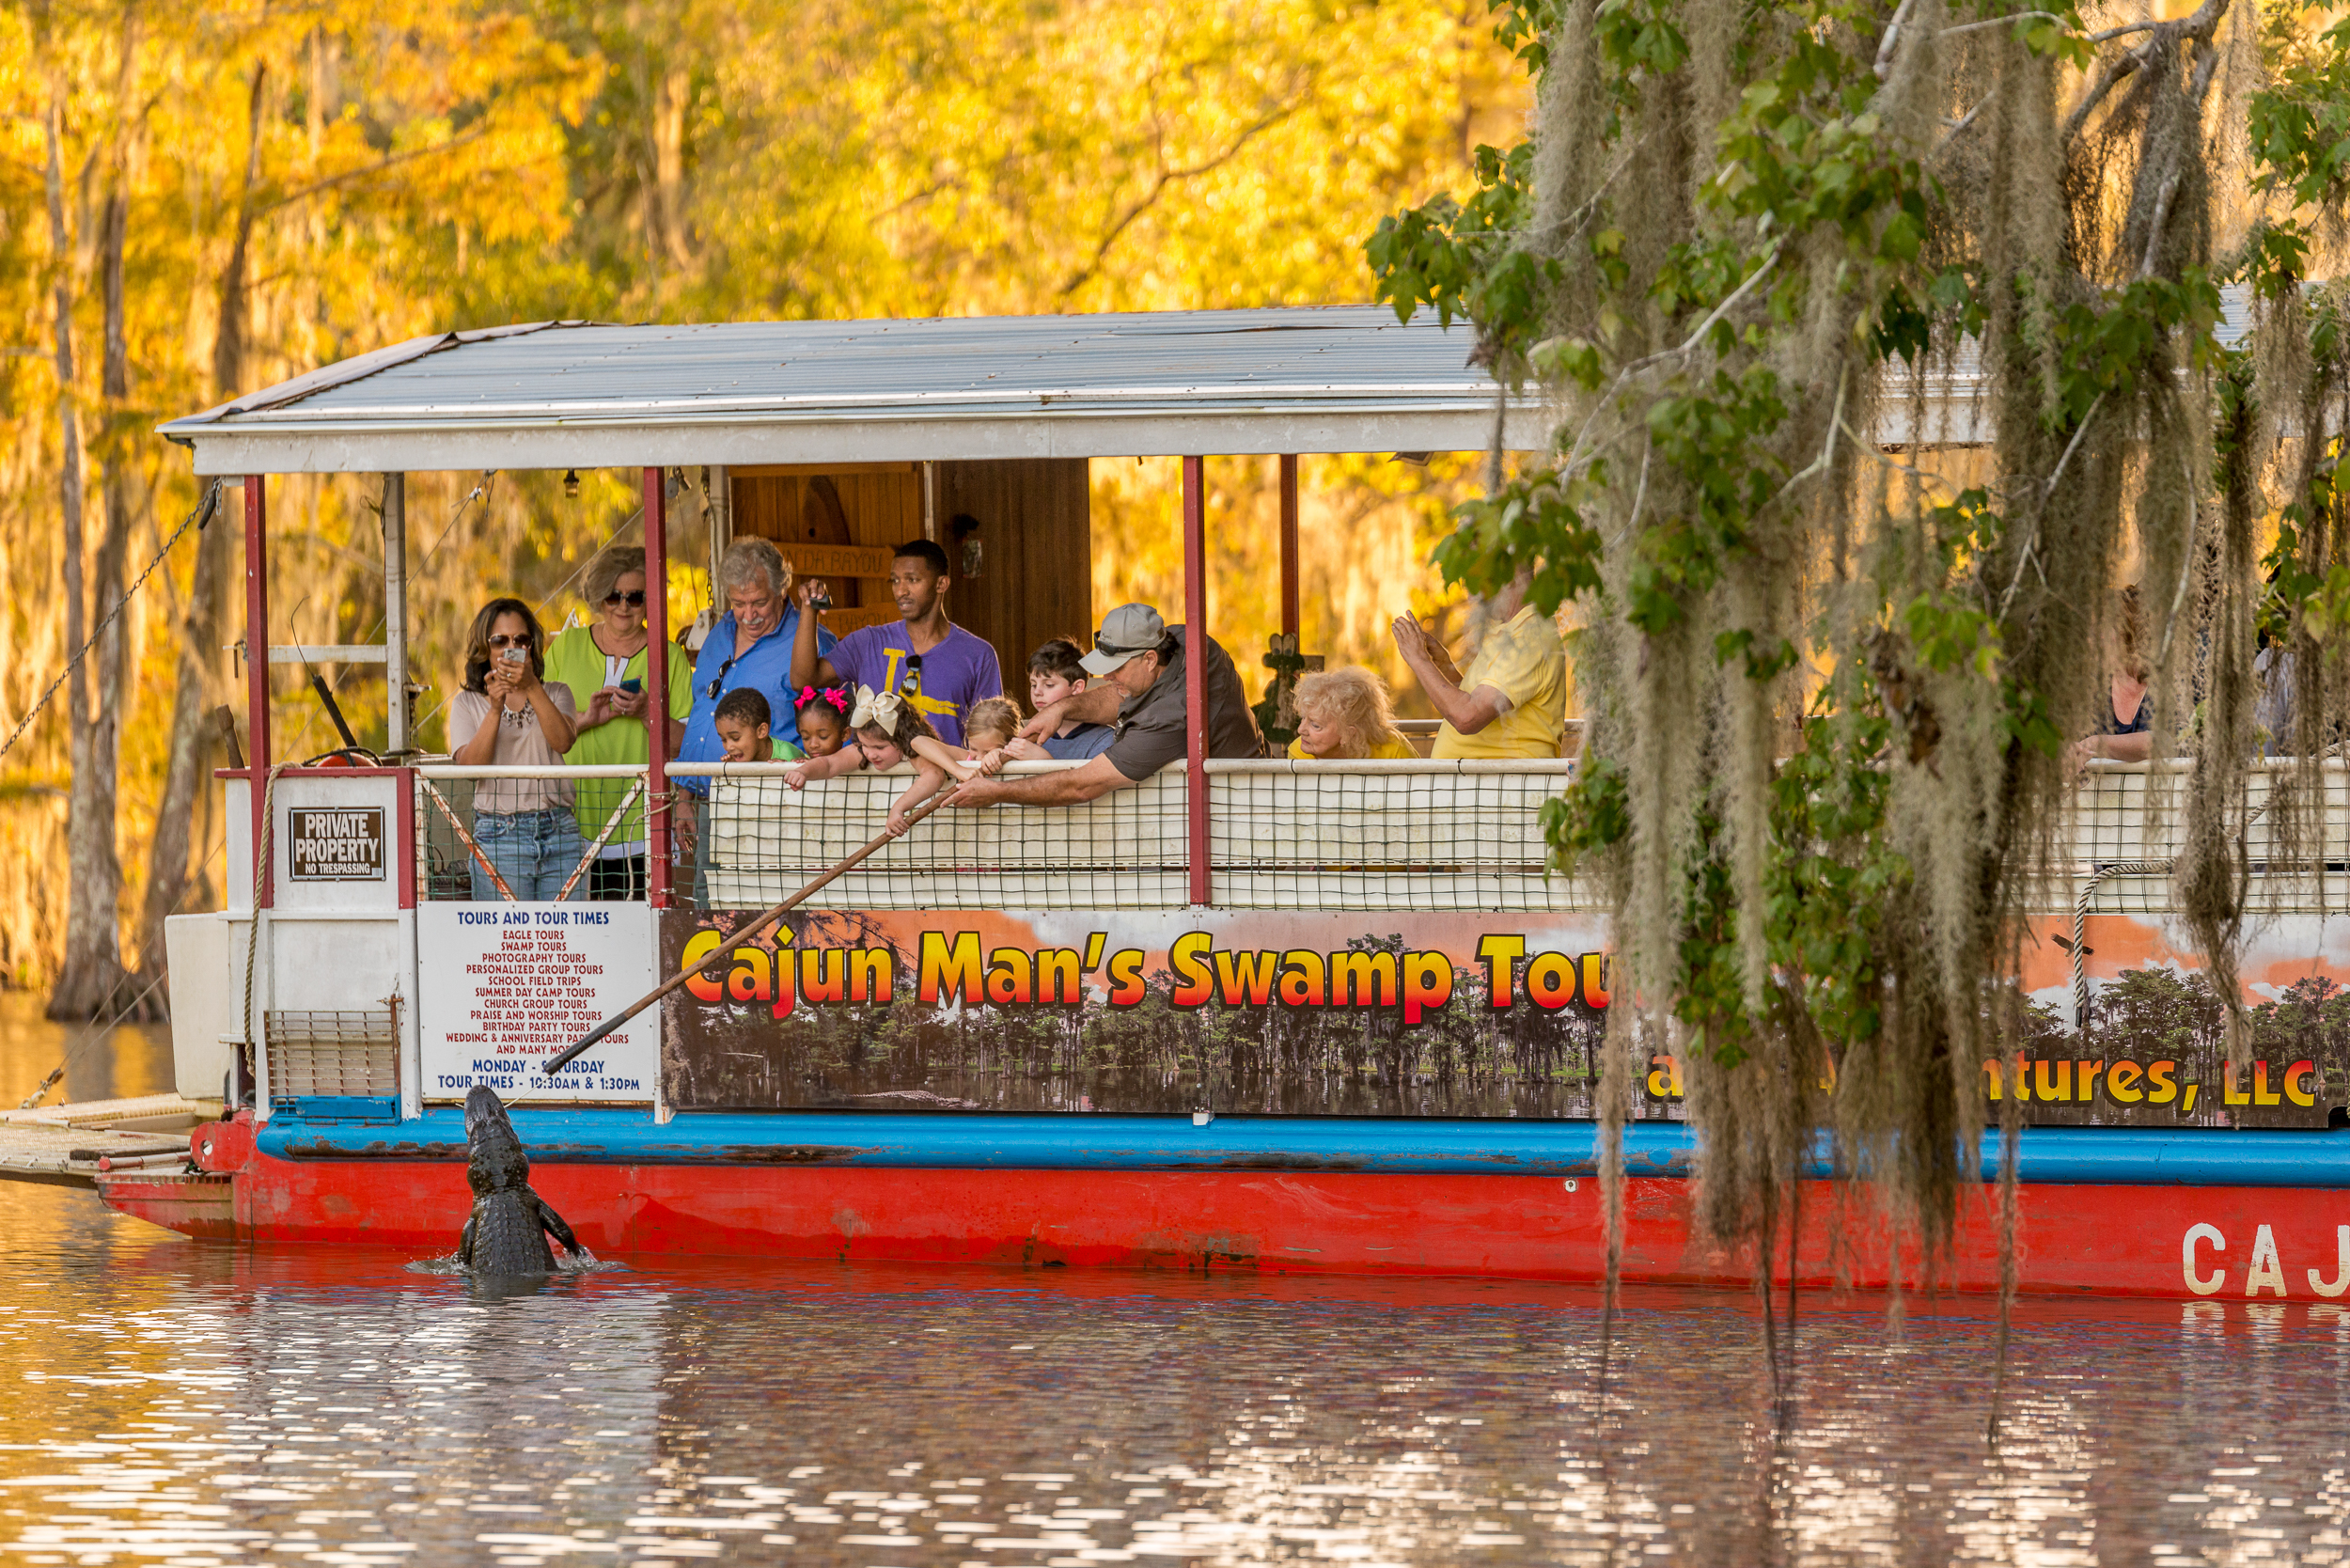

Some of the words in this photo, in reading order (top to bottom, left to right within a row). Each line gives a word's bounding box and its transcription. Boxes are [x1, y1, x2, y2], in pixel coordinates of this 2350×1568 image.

[831, 553, 883, 573] BAYOU
[305, 813, 368, 839] PRIVATE
[295, 838, 379, 863] PROPERTY
[305, 863, 317, 874] NO
[319, 863, 370, 875] TRESPASSING
[458, 912, 497, 925] TOURS
[503, 912, 529, 924] AND
[535, 912, 568, 925] TOUR
[572, 912, 609, 924] TIMES
[503, 930, 532, 940] EAGLE
[535, 930, 564, 940] TOURS
[501, 941, 534, 951] SWAMP
[537, 941, 567, 952] TOURS
[482, 952, 554, 963] PHOTOGRAPHY
[556, 953, 587, 964] TOURS
[466, 964, 535, 975] PERSONALIZED
[538, 964, 571, 975] GROUP
[573, 964, 603, 975] TOURS
[488, 976, 526, 986] SCHOOL
[528, 976, 554, 986] FIELD
[556, 976, 582, 986] TRIPS
[679, 925, 893, 1021] Cajun
[916, 930, 1148, 1010] Man's
[1167, 931, 1454, 1030] Swamp
[475, 987, 512, 997] SUMMER
[515, 987, 532, 997] DAY
[536, 987, 563, 997] CAMP
[566, 987, 596, 998] TOURS
[484, 998, 519, 1009] CHURCH
[522, 998, 555, 1010] GROUP
[557, 998, 588, 1010] TOURS
[470, 1010, 503, 1020] PRAISE
[505, 1011, 525, 1020] AND
[527, 1011, 570, 1021] WORSHIP
[572, 1011, 603, 1021] TOURS
[482, 1021, 525, 1031] BIRTHDAY
[528, 1022, 557, 1032] PARTY
[560, 1022, 590, 1032] TOURS
[446, 1032, 488, 1043] WEDDING
[491, 1033, 497, 1043] &
[501, 1033, 563, 1043] ANNIVERSARY
[496, 1044, 516, 1055] AND
[519, 1045, 546, 1055] MANY
[472, 1059, 525, 1073] MONDAY
[438, 1075, 473, 1088] TOUR
[478, 1075, 514, 1089] TIMES
[529, 1076, 580, 1089] 10:30AM
[585, 1077, 593, 1090] &
[600, 1077, 639, 1090] 1:30PM
[2219, 1058, 2317, 1108] LLC
